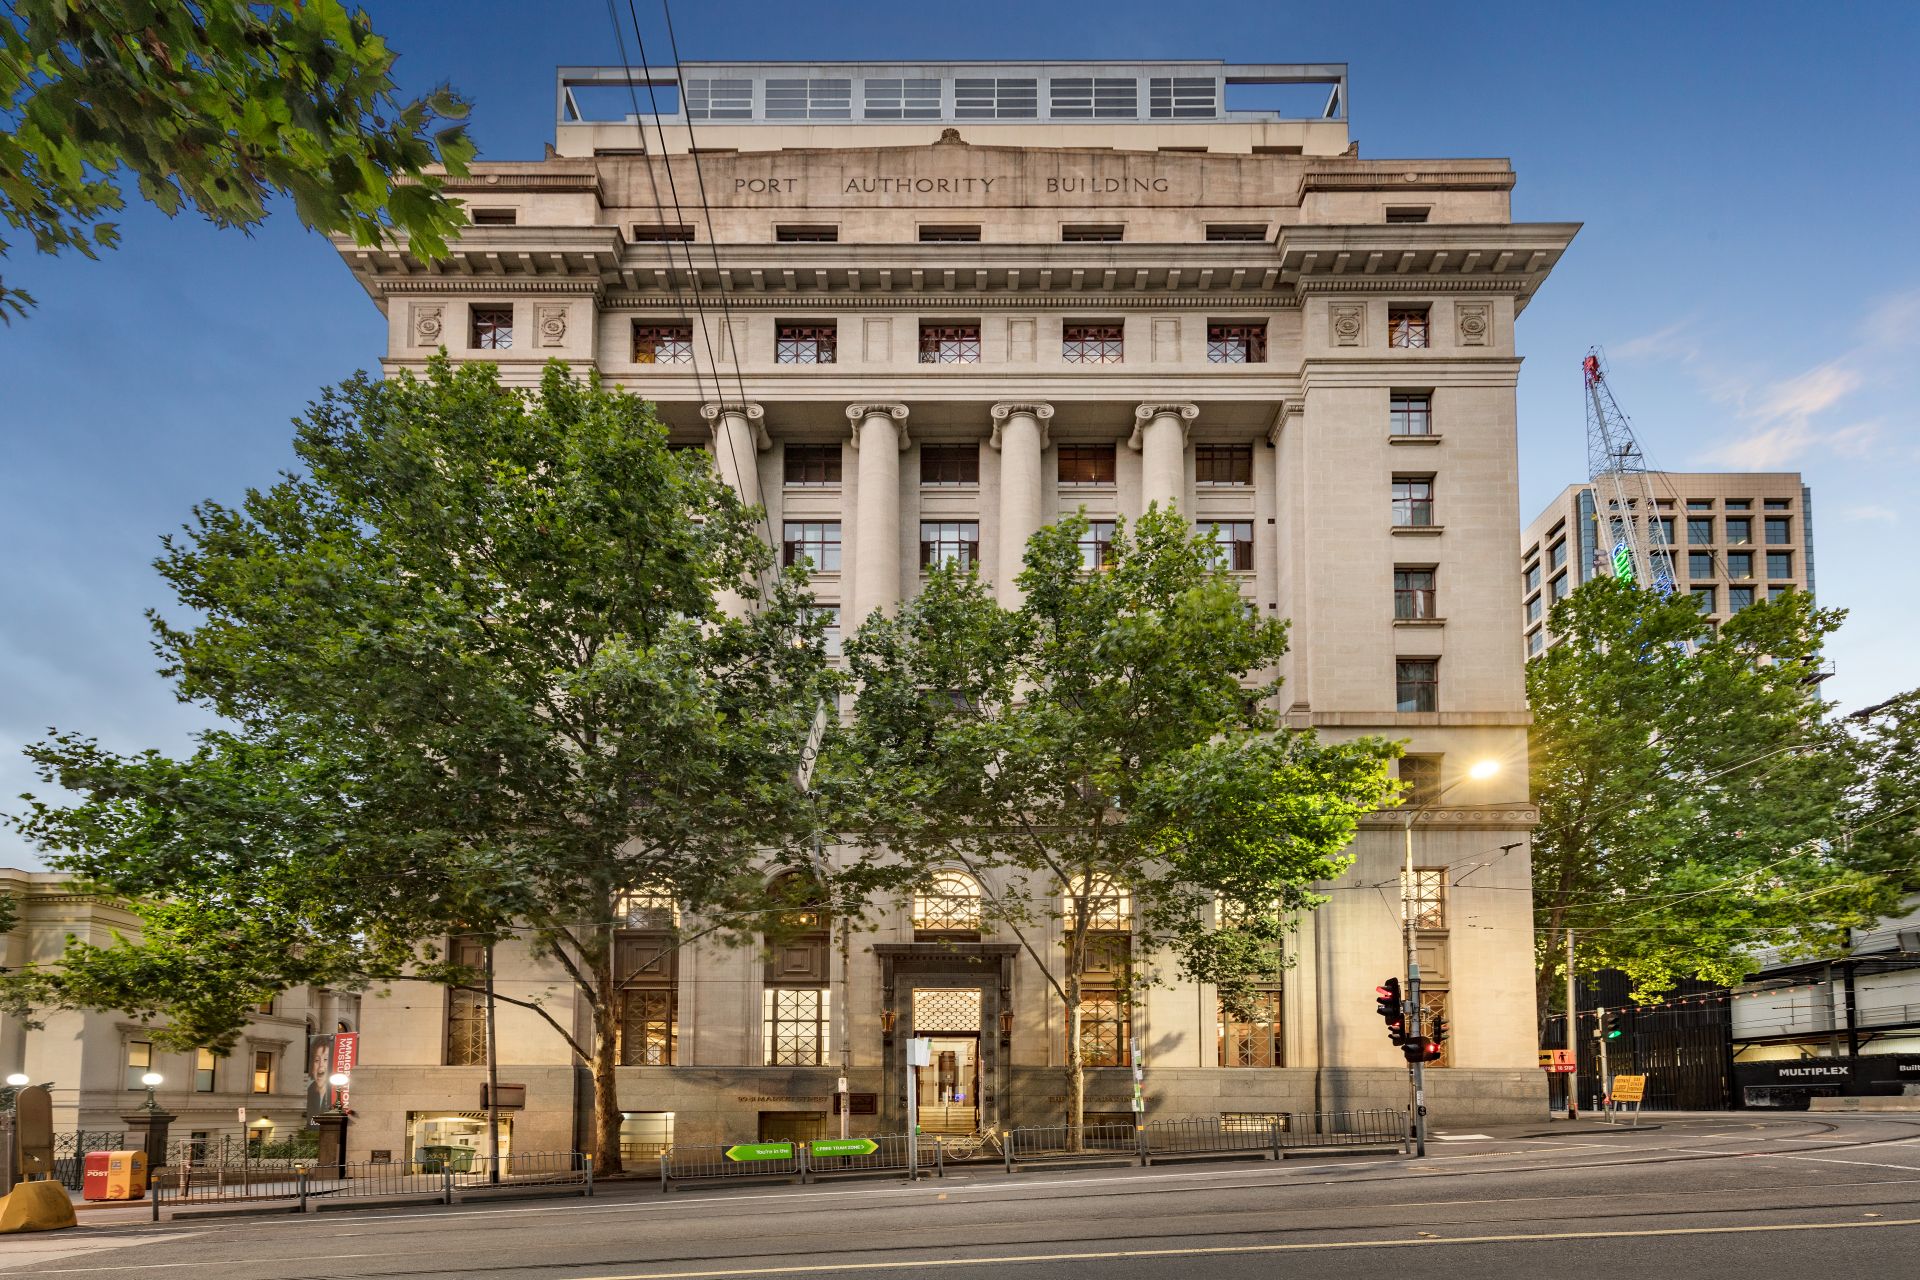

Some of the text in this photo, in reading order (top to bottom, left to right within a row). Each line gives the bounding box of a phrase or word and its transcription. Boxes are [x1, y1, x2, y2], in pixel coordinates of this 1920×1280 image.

[735, 177, 1169, 193] PORT AUTHORITY BUILDING
[342, 1037, 353, 1108] IMMIGRTION
[1779, 1066, 1849, 1077] MULTIPLEX
